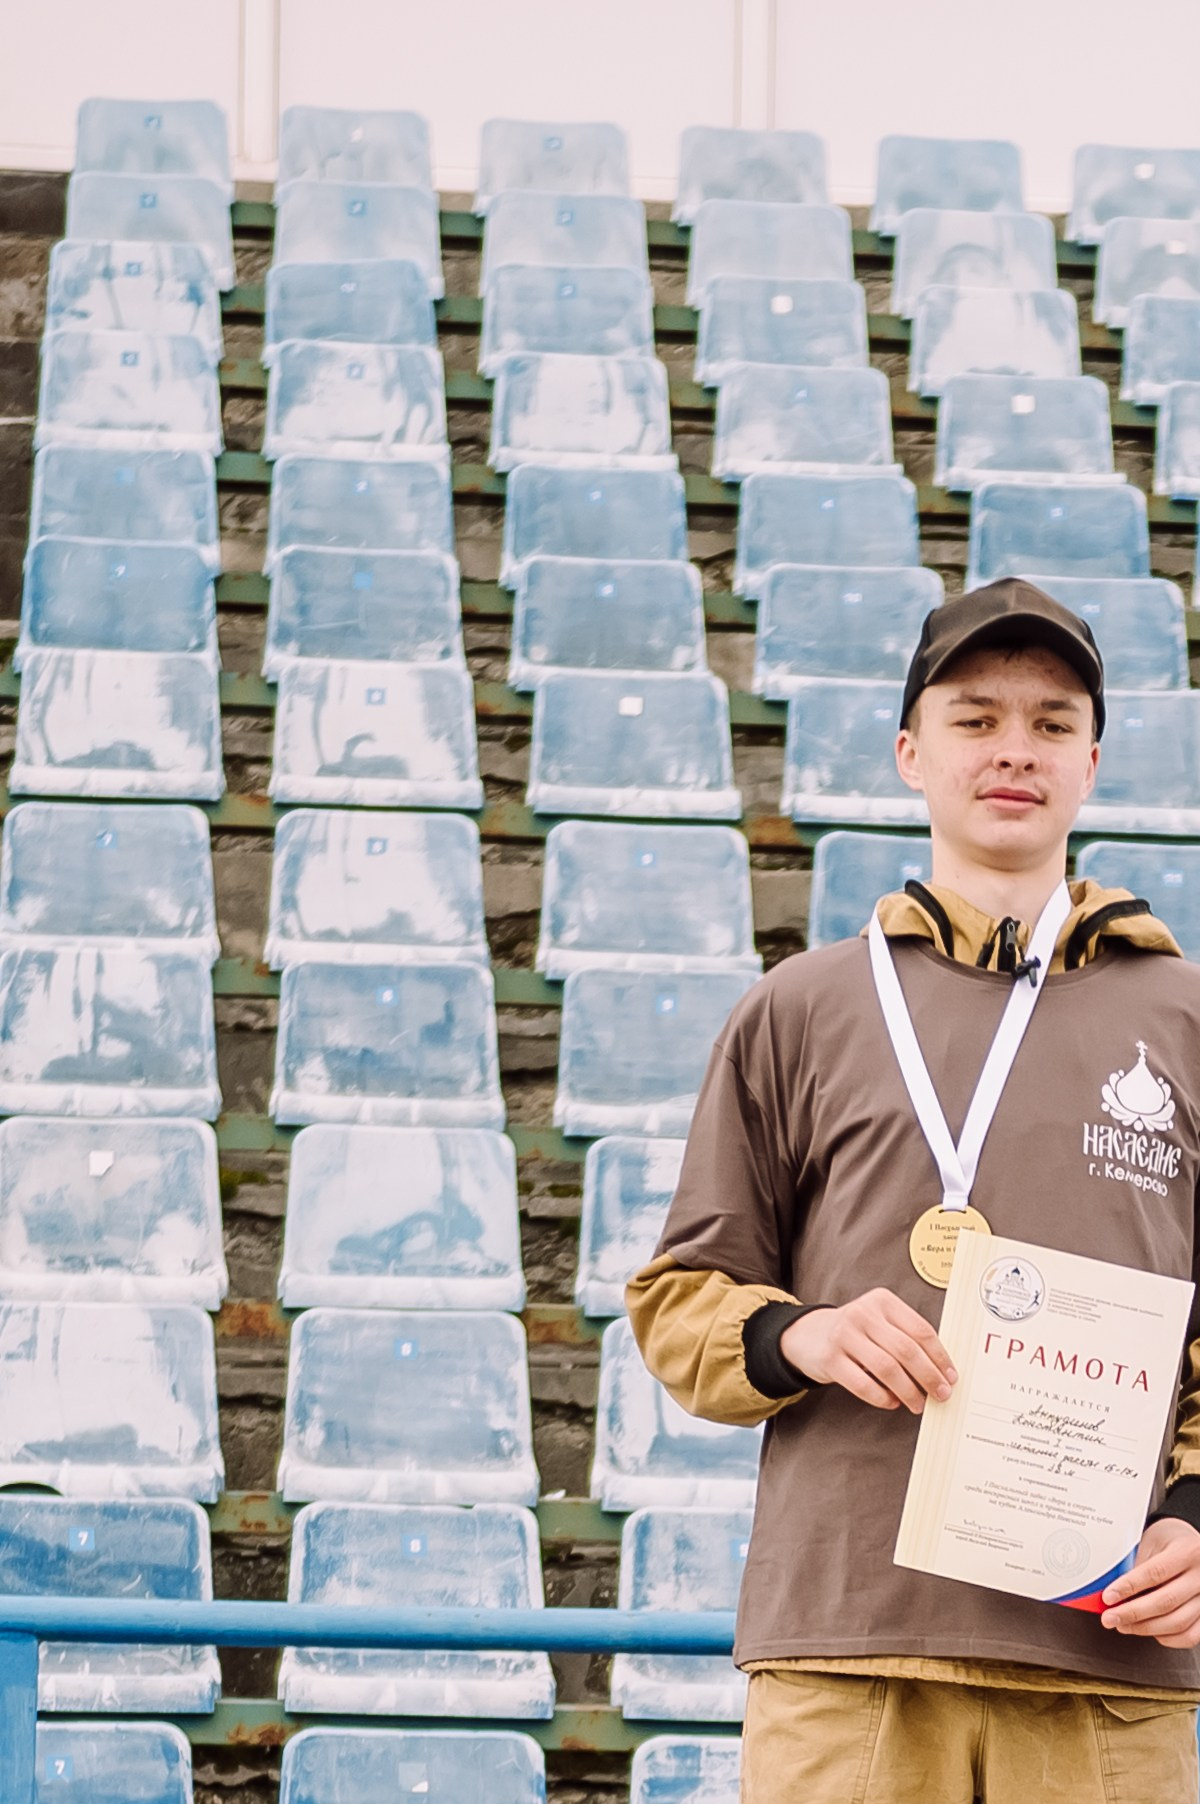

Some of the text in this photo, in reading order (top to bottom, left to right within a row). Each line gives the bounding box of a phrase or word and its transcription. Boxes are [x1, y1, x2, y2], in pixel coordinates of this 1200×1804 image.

[1105, 1162, 1168, 1197] Кемерово
[984, 1333, 1150, 1392] ГРАМОТА
[1009, 1381, 1111, 1414] НАГРАЖДАЕТСЯ
[77, 1531, 89, 1546] 7
[55, 1760, 66, 1775] 7
